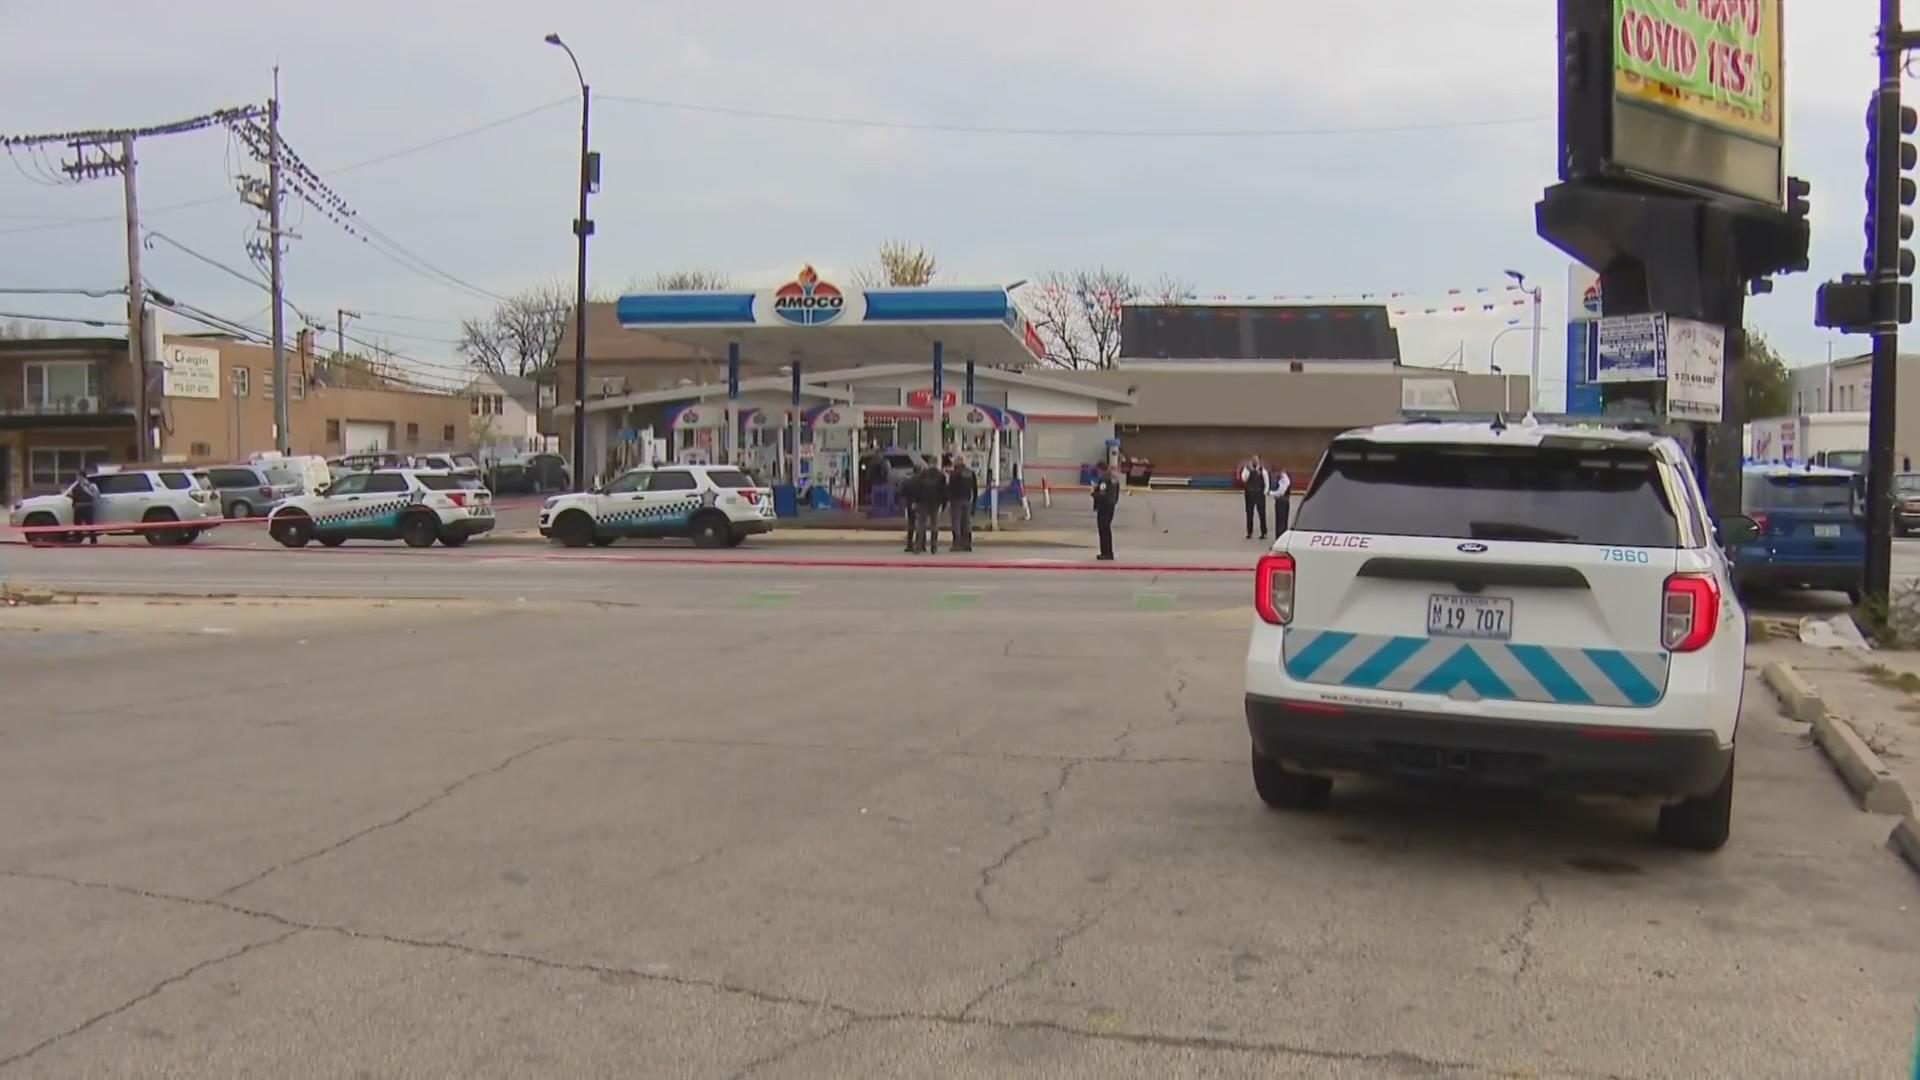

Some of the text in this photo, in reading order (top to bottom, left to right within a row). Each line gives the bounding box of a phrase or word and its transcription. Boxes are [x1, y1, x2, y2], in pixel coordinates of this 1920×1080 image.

[1621, 10, 1698, 79] COVID
[774, 296, 844, 309] AMOCO
[1655, 318, 1666, 377] WARNING
[1310, 534, 1372, 549] POLICE
[1461, 542, 1484, 552] Ford
[1602, 549, 1649, 564] 7960
[1445, 607, 1466, 630] 19
[1475, 608, 1505, 633] 707
